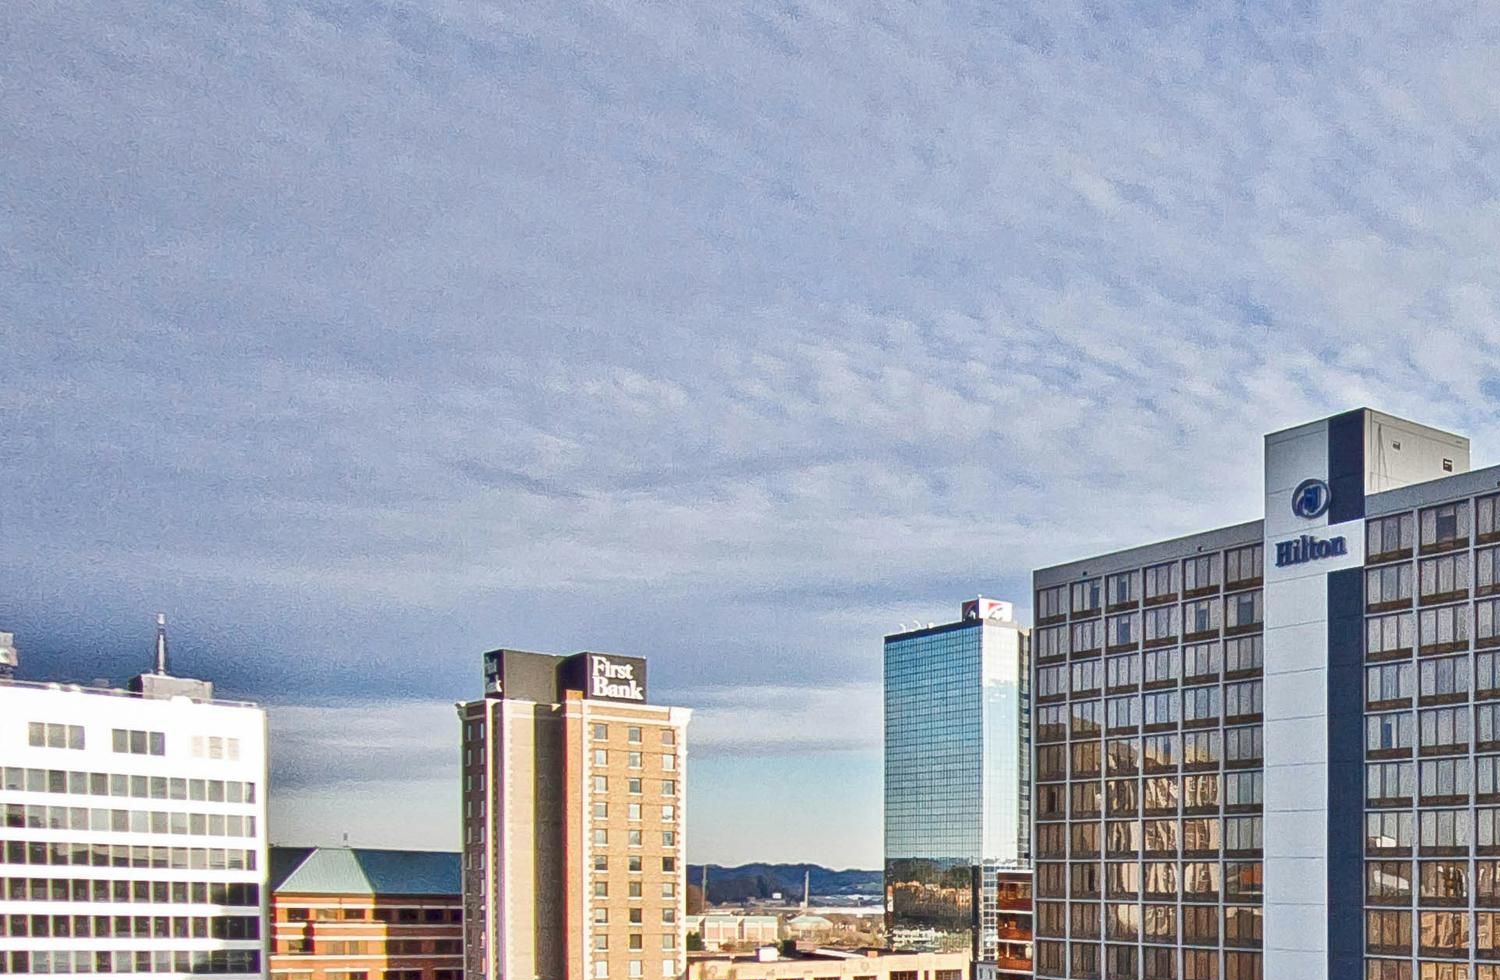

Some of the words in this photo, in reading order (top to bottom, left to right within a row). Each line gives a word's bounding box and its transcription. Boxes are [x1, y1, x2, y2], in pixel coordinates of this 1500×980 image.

[1275, 534, 1347, 567] Hilton
[592, 656, 633, 679] First
[592, 677, 644, 699] Bank
